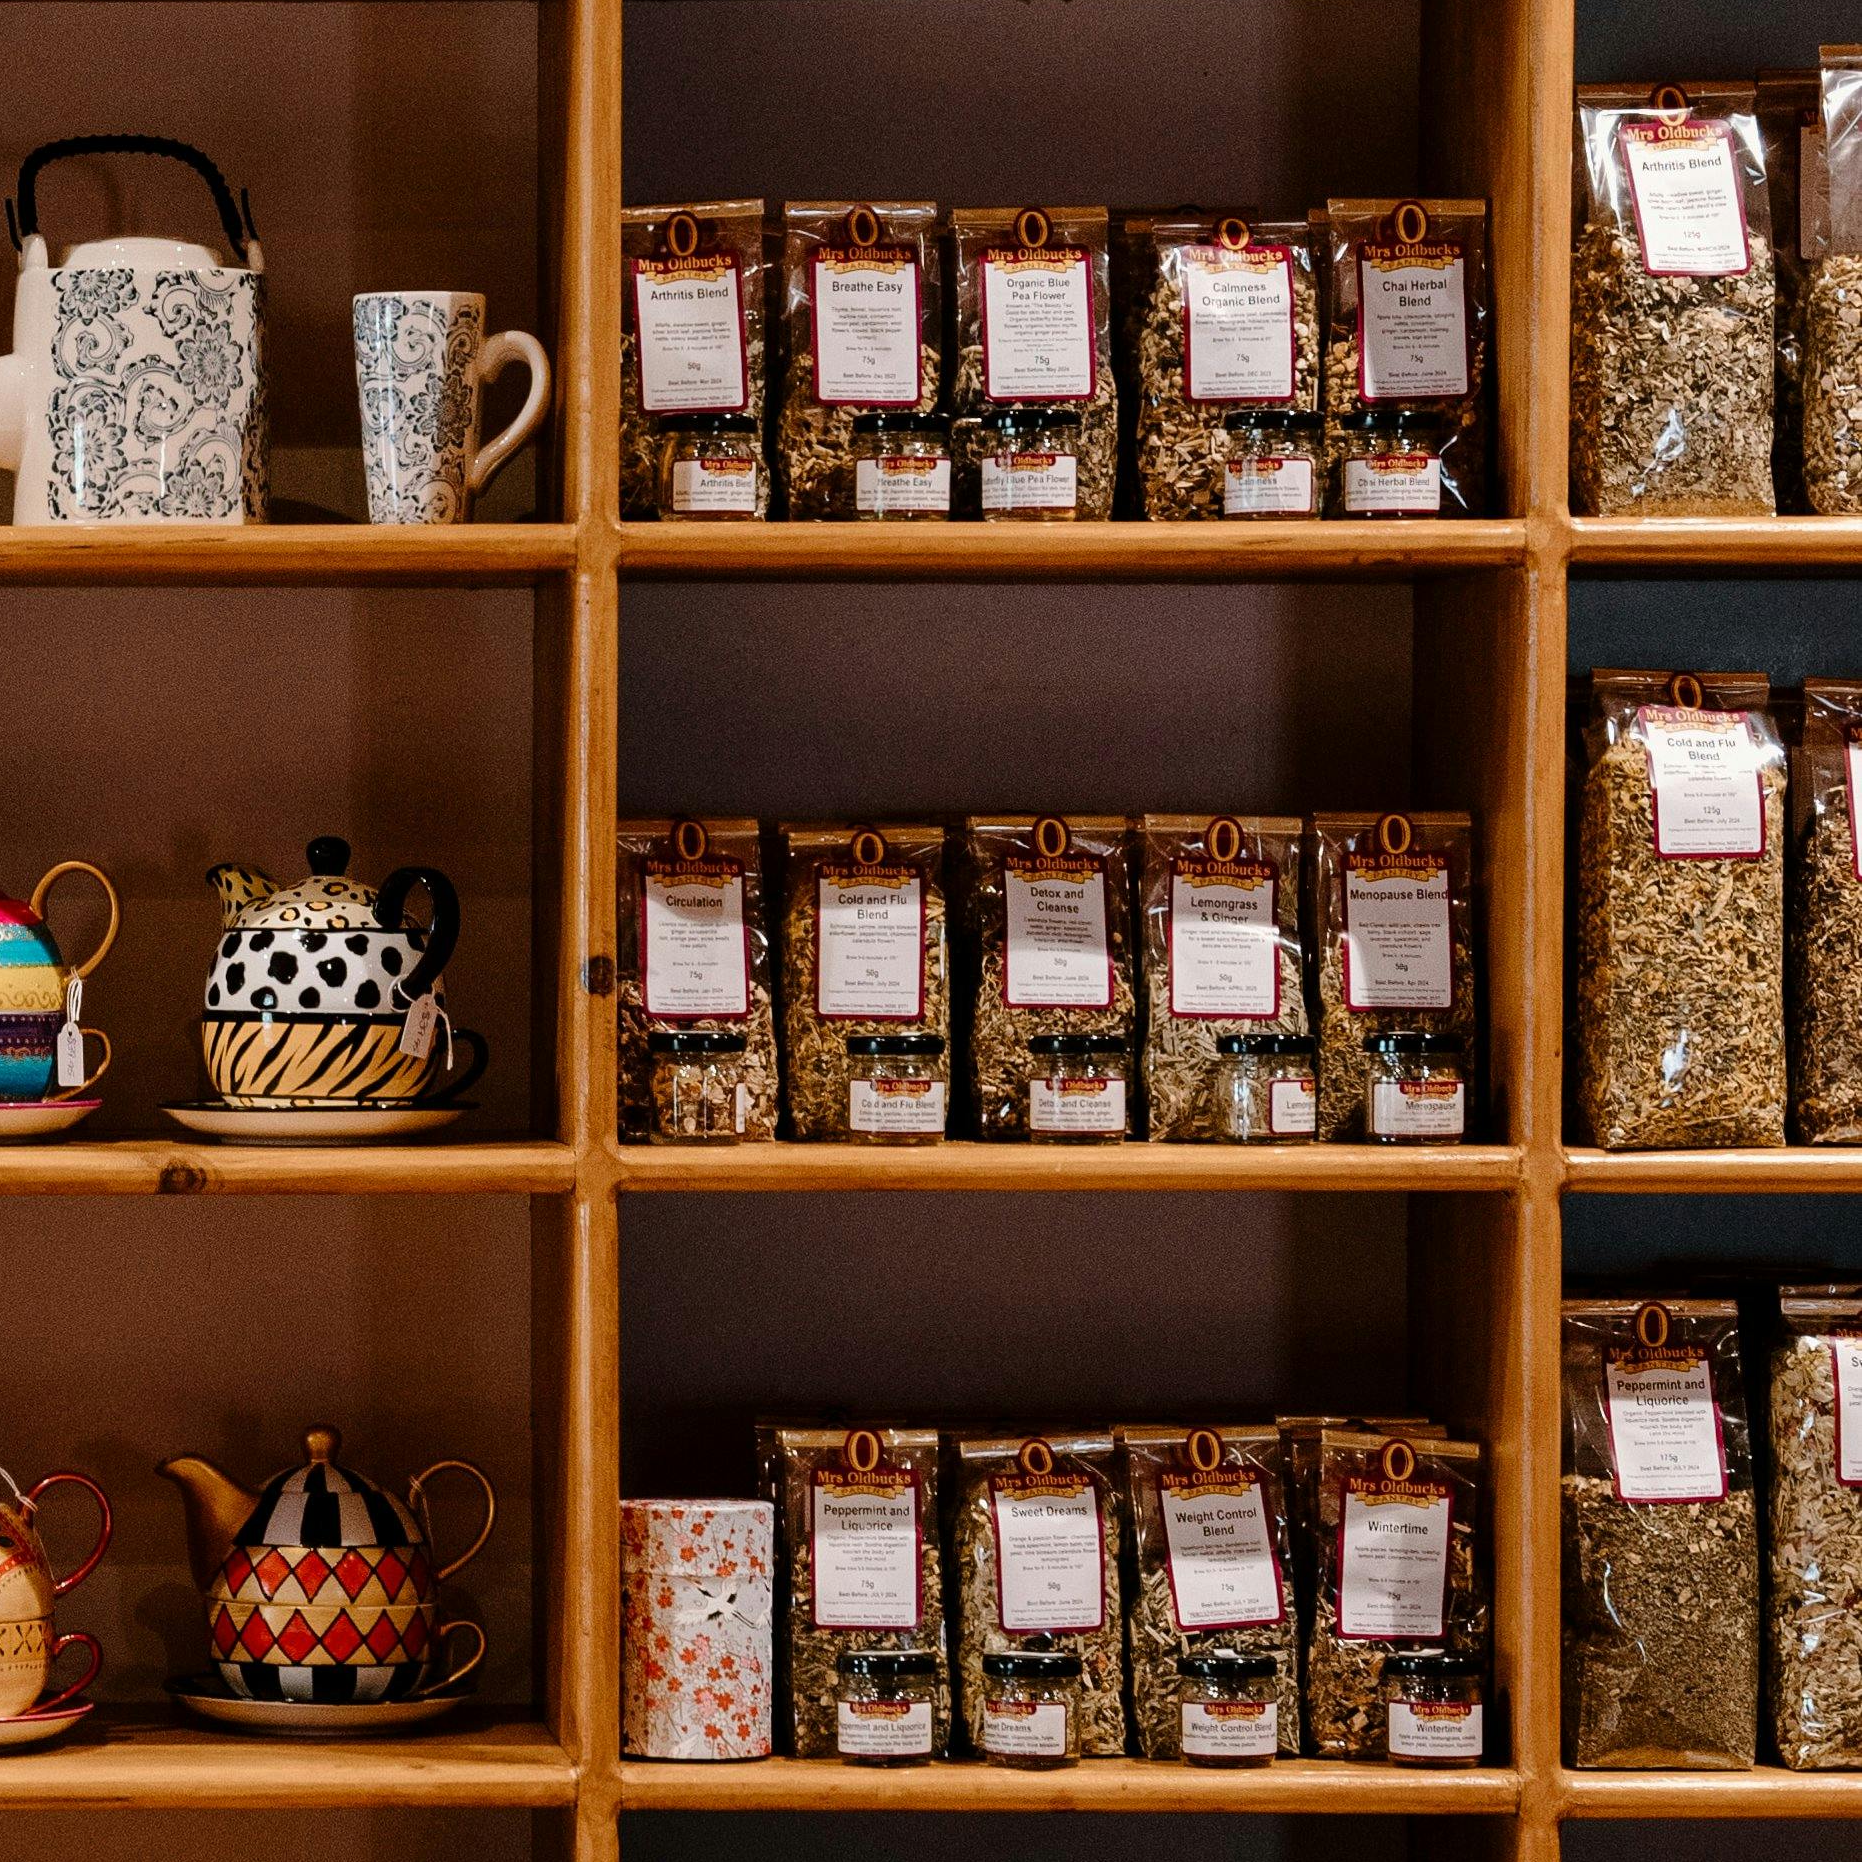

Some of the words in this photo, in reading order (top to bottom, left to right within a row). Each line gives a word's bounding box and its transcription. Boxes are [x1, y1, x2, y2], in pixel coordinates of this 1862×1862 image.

[1643, 161, 1685, 171] Arthritis
[1689, 157, 1721, 168] Blend
[986, 250, 1014, 262] Mrs
[1018, 249, 1080, 261] Oldbucks
[638, 259, 663, 273] Mrs
[668, 255, 731, 270] Oldbucks
[833, 281, 872, 291] Breathe
[876, 282, 902, 294] Easy
[1007, 279, 1044, 289] Organic
[1048, 278, 1069, 287] Blue
[1214, 283, 1266, 292] Calmness
[1383, 281, 1406, 291] Chai
[1410, 279, 1446, 290] Herbal
[651, 289, 693, 299] Arthritis
[698, 287, 728, 298] Blend
[1034, 291, 1065, 299] Flower
[1203, 297, 1244, 306] Organic
[1249, 295, 1279, 304] Blend
[1400, 296, 1431, 306] Blend
[1667, 738, 1692, 747] Cold
[1696, 739, 1715, 747] and
[1689, 751, 1719, 760] Blend
[1177, 861, 1202, 873] Mrs
[1207, 863, 1270, 876] Oldbucks
[1031, 887, 1061, 898] Detox
[1064, 889, 1083, 898] and
[1349, 888, 1413, 903] Menopause
[1417, 888, 1449, 902] Blend
[666, 895, 722, 907] Circulation
[838, 894, 863, 904] Cold
[867, 896, 887, 904] and
[890, 895, 906, 904] Flu
[1191, 897, 1257, 911] Lemongrass
[1037, 901, 1078, 913] Cleanse
[858, 909, 888, 919] Blend
[1201, 912, 1208, 921] &
[1212, 912, 1248, 923] Ginger
[1617, 1380, 1681, 1393] Peppermint
[1685, 1379, 1705, 1389] and
[1635, 1393, 1688, 1406] Liquorice
[818, 1471, 843, 1483] Mrs
[848, 1473, 911, 1484] Oldbucks
[825, 1505, 886, 1517] Peppermint
[890, 1507, 909, 1516] and
[1012, 1507, 1043, 1517] Sweet
[1047, 1506, 1087, 1516] Dreams
[1176, 1512, 1214, 1524] Weight
[1217, 1508, 1256, 1520] Control
[842, 1520, 892, 1530] Liquorice
[1203, 1526, 1234, 1536] Blend
[1369, 1521, 1428, 1534] Wintertime
[1417, 1724, 1462, 1733] Wintertime
